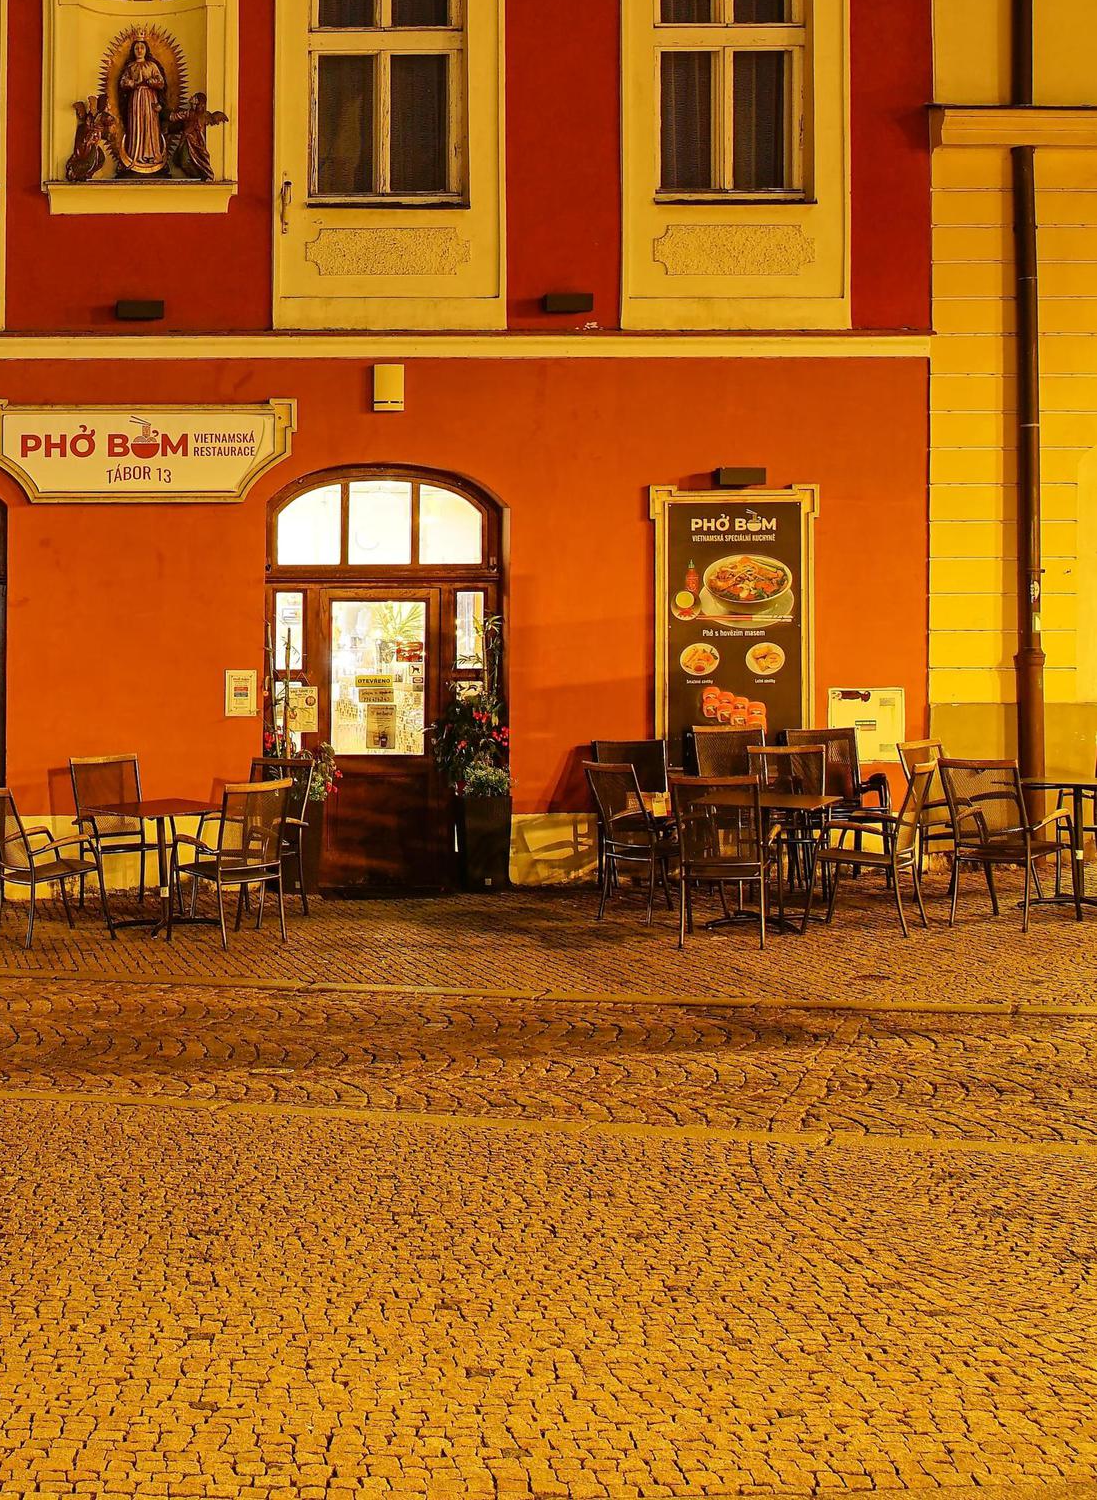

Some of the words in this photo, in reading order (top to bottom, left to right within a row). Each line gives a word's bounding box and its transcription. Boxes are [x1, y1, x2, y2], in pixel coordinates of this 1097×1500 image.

[193, 430, 255, 444] VIETNAMSKÁ
[193, 446, 256, 457] RESTAURACE
[106, 463, 151, 484] TÁBOR
[155, 467, 172, 484] 13
